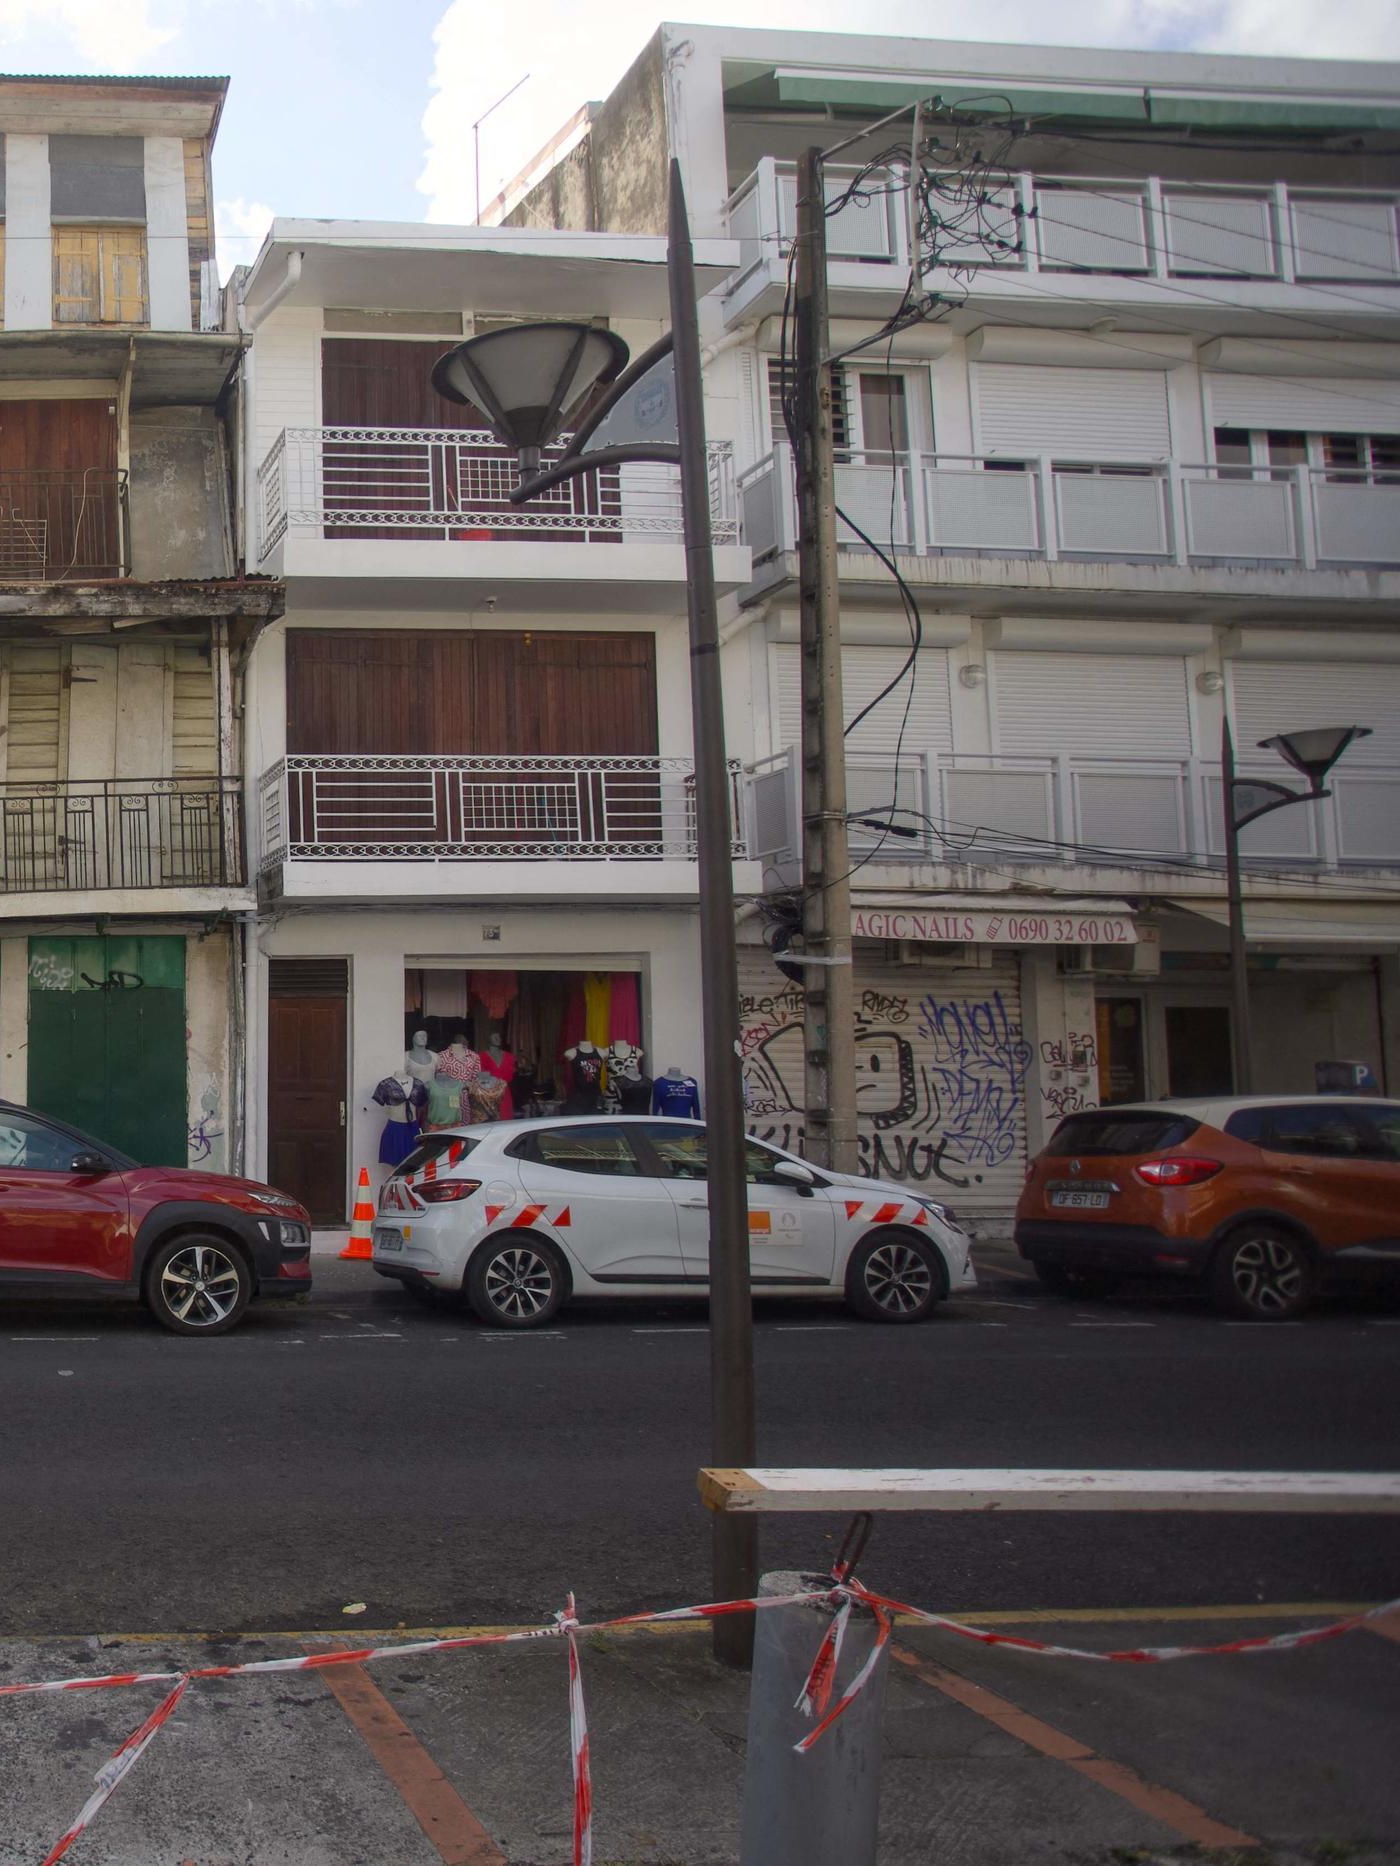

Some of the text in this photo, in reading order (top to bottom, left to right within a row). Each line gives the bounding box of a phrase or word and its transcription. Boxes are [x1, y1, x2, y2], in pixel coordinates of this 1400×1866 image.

[911, 915, 975, 941] NAILS
[1008, 918, 1049, 941] 0690
[1054, 919, 1074, 941] 32
[1077, 919, 1098, 942] 60
[1103, 920, 1128, 943] 02
